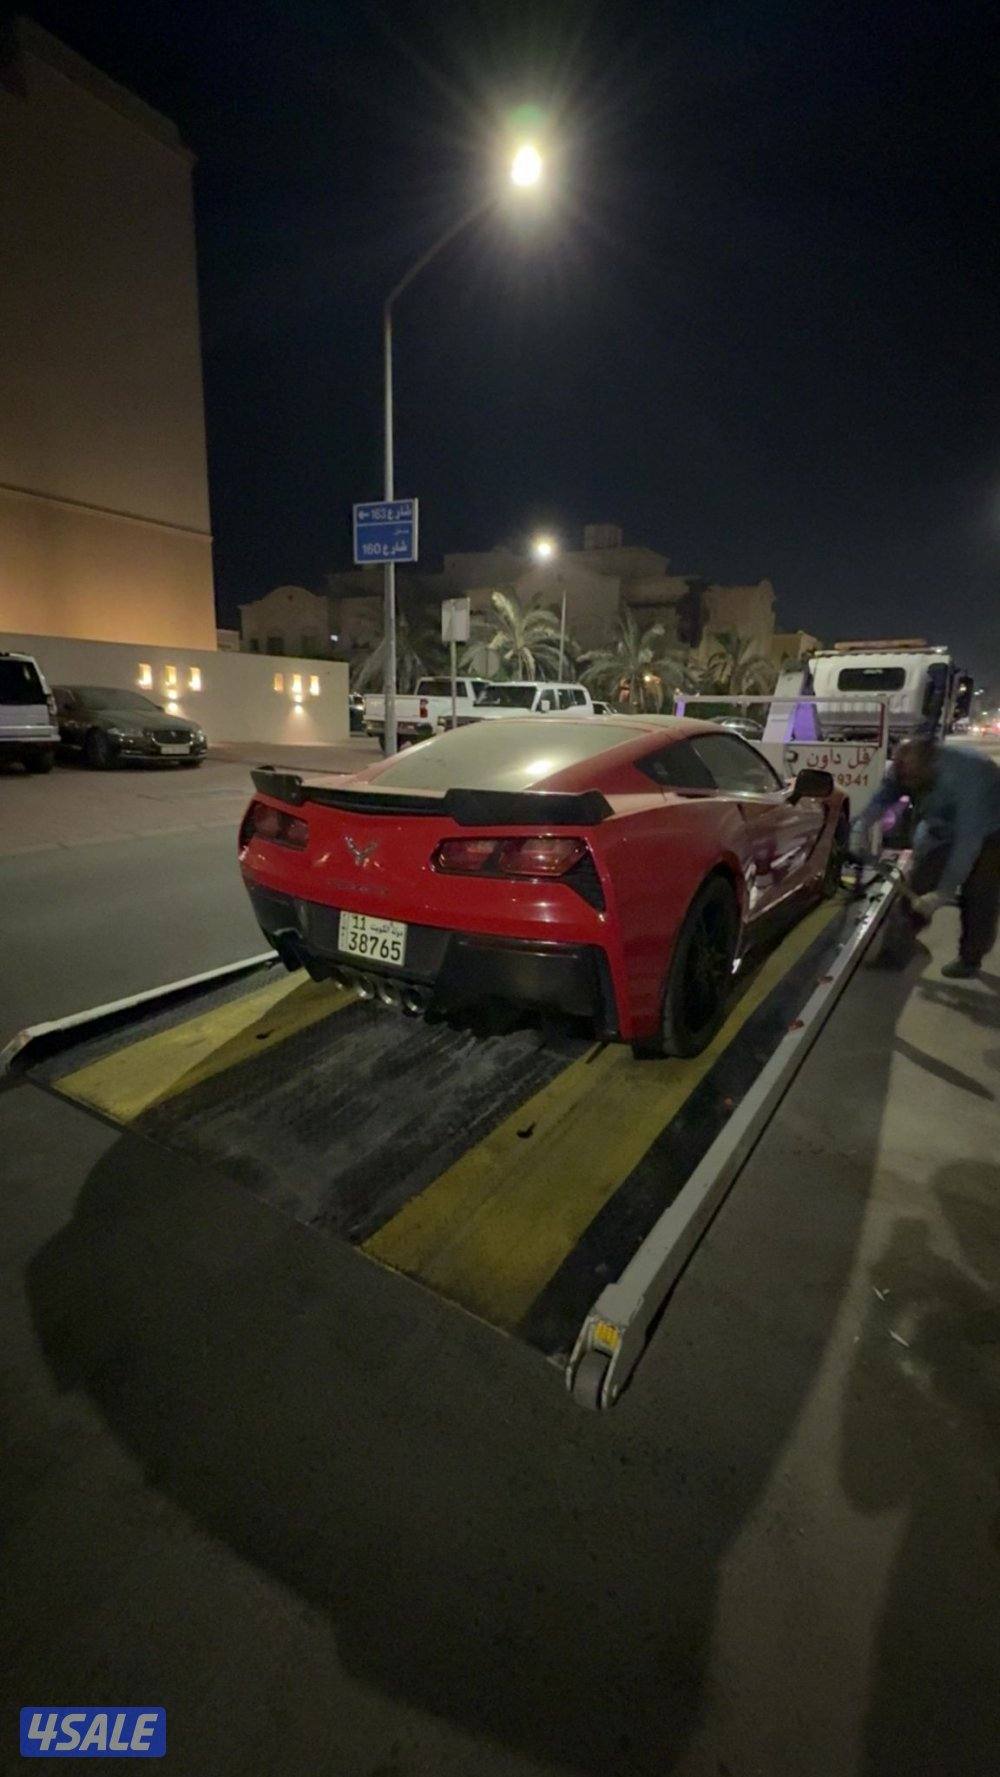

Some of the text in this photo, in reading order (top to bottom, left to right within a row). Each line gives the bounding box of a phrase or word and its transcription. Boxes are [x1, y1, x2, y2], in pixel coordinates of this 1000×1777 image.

[387, 503, 411, 520] شارع
[362, 539, 408, 557] شارع 160
[806, 748, 841, 769] داون
[833, 773, 869, 786] 9341
[351, 915, 366, 931] 11
[348, 931, 402, 961] 38765
